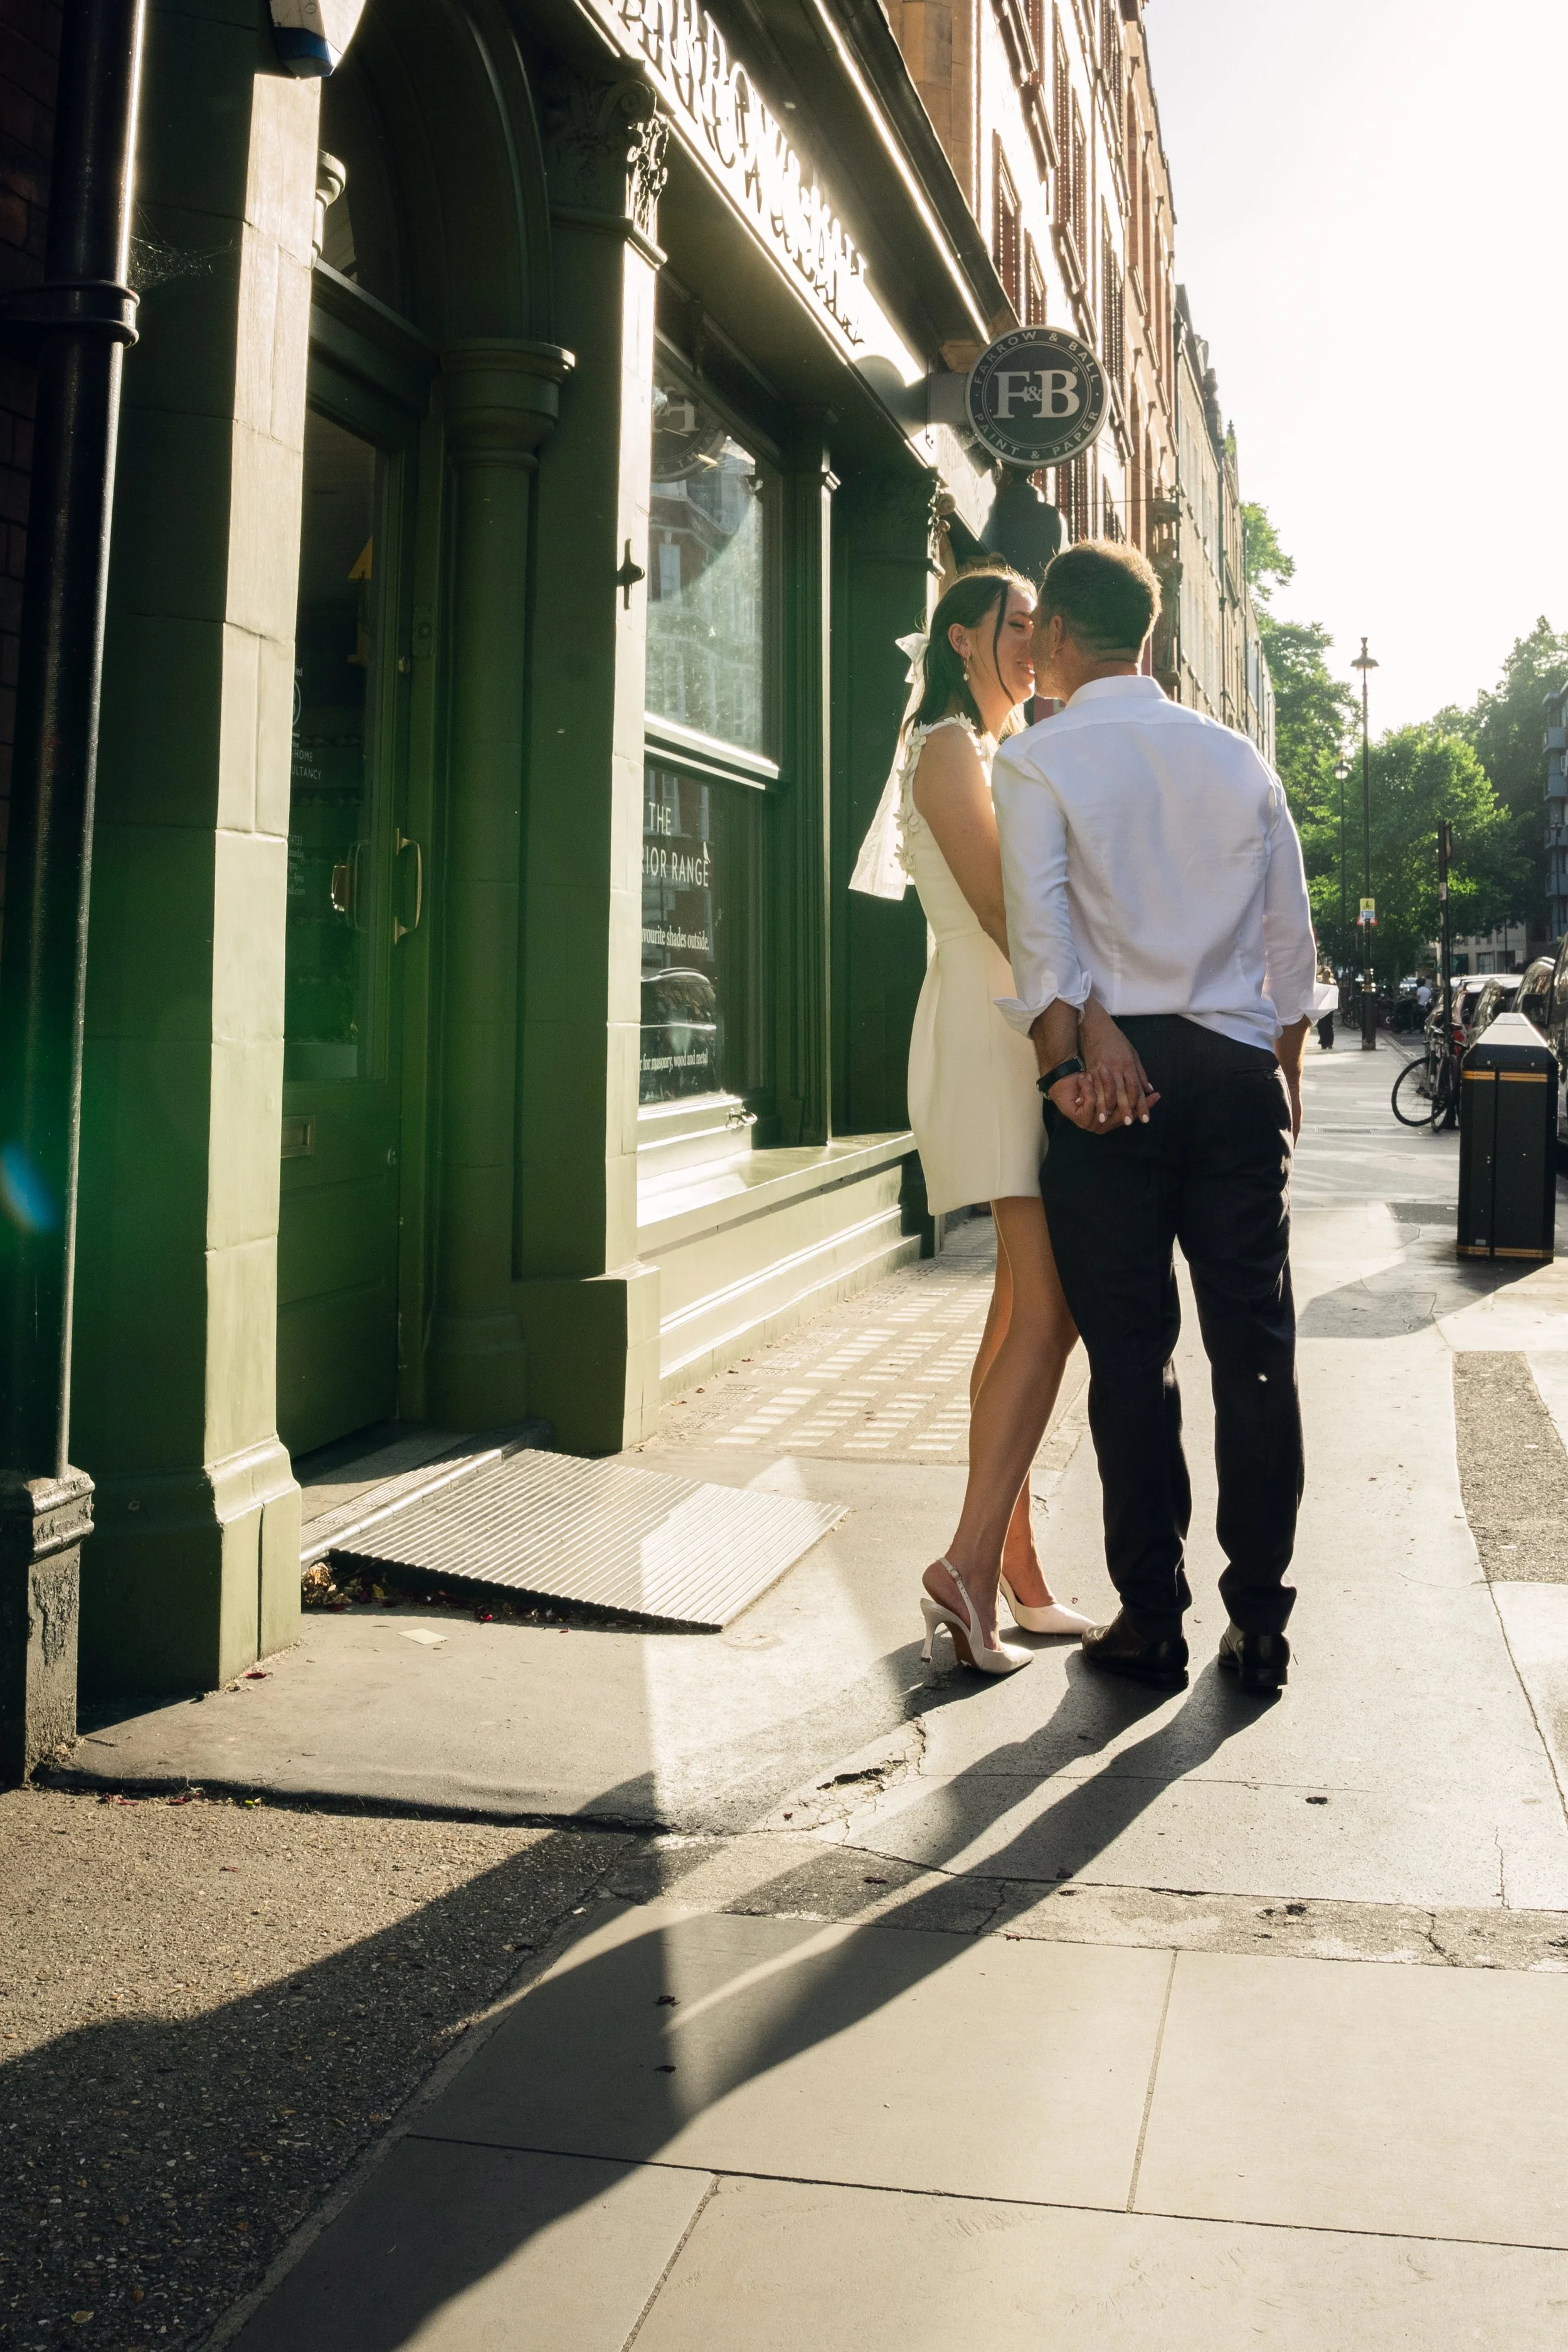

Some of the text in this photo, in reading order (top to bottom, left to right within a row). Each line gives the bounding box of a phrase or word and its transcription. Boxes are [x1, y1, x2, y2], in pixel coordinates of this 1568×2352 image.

[975, 331, 1099, 384] FARROW & BALL
[975, 411, 1099, 460] PAINT & PAPER
[649, 802, 672, 835] THE
[672, 852, 709, 887] RANGE
[666, 925, 686, 948] shades
[687, 930, 709, 951] outside.
[650, 1056, 673, 1075] masonry,
[674, 1050, 687, 1067] wood
[687, 1049, 696, 1066] and
[696, 1048, 708, 1064] metal
